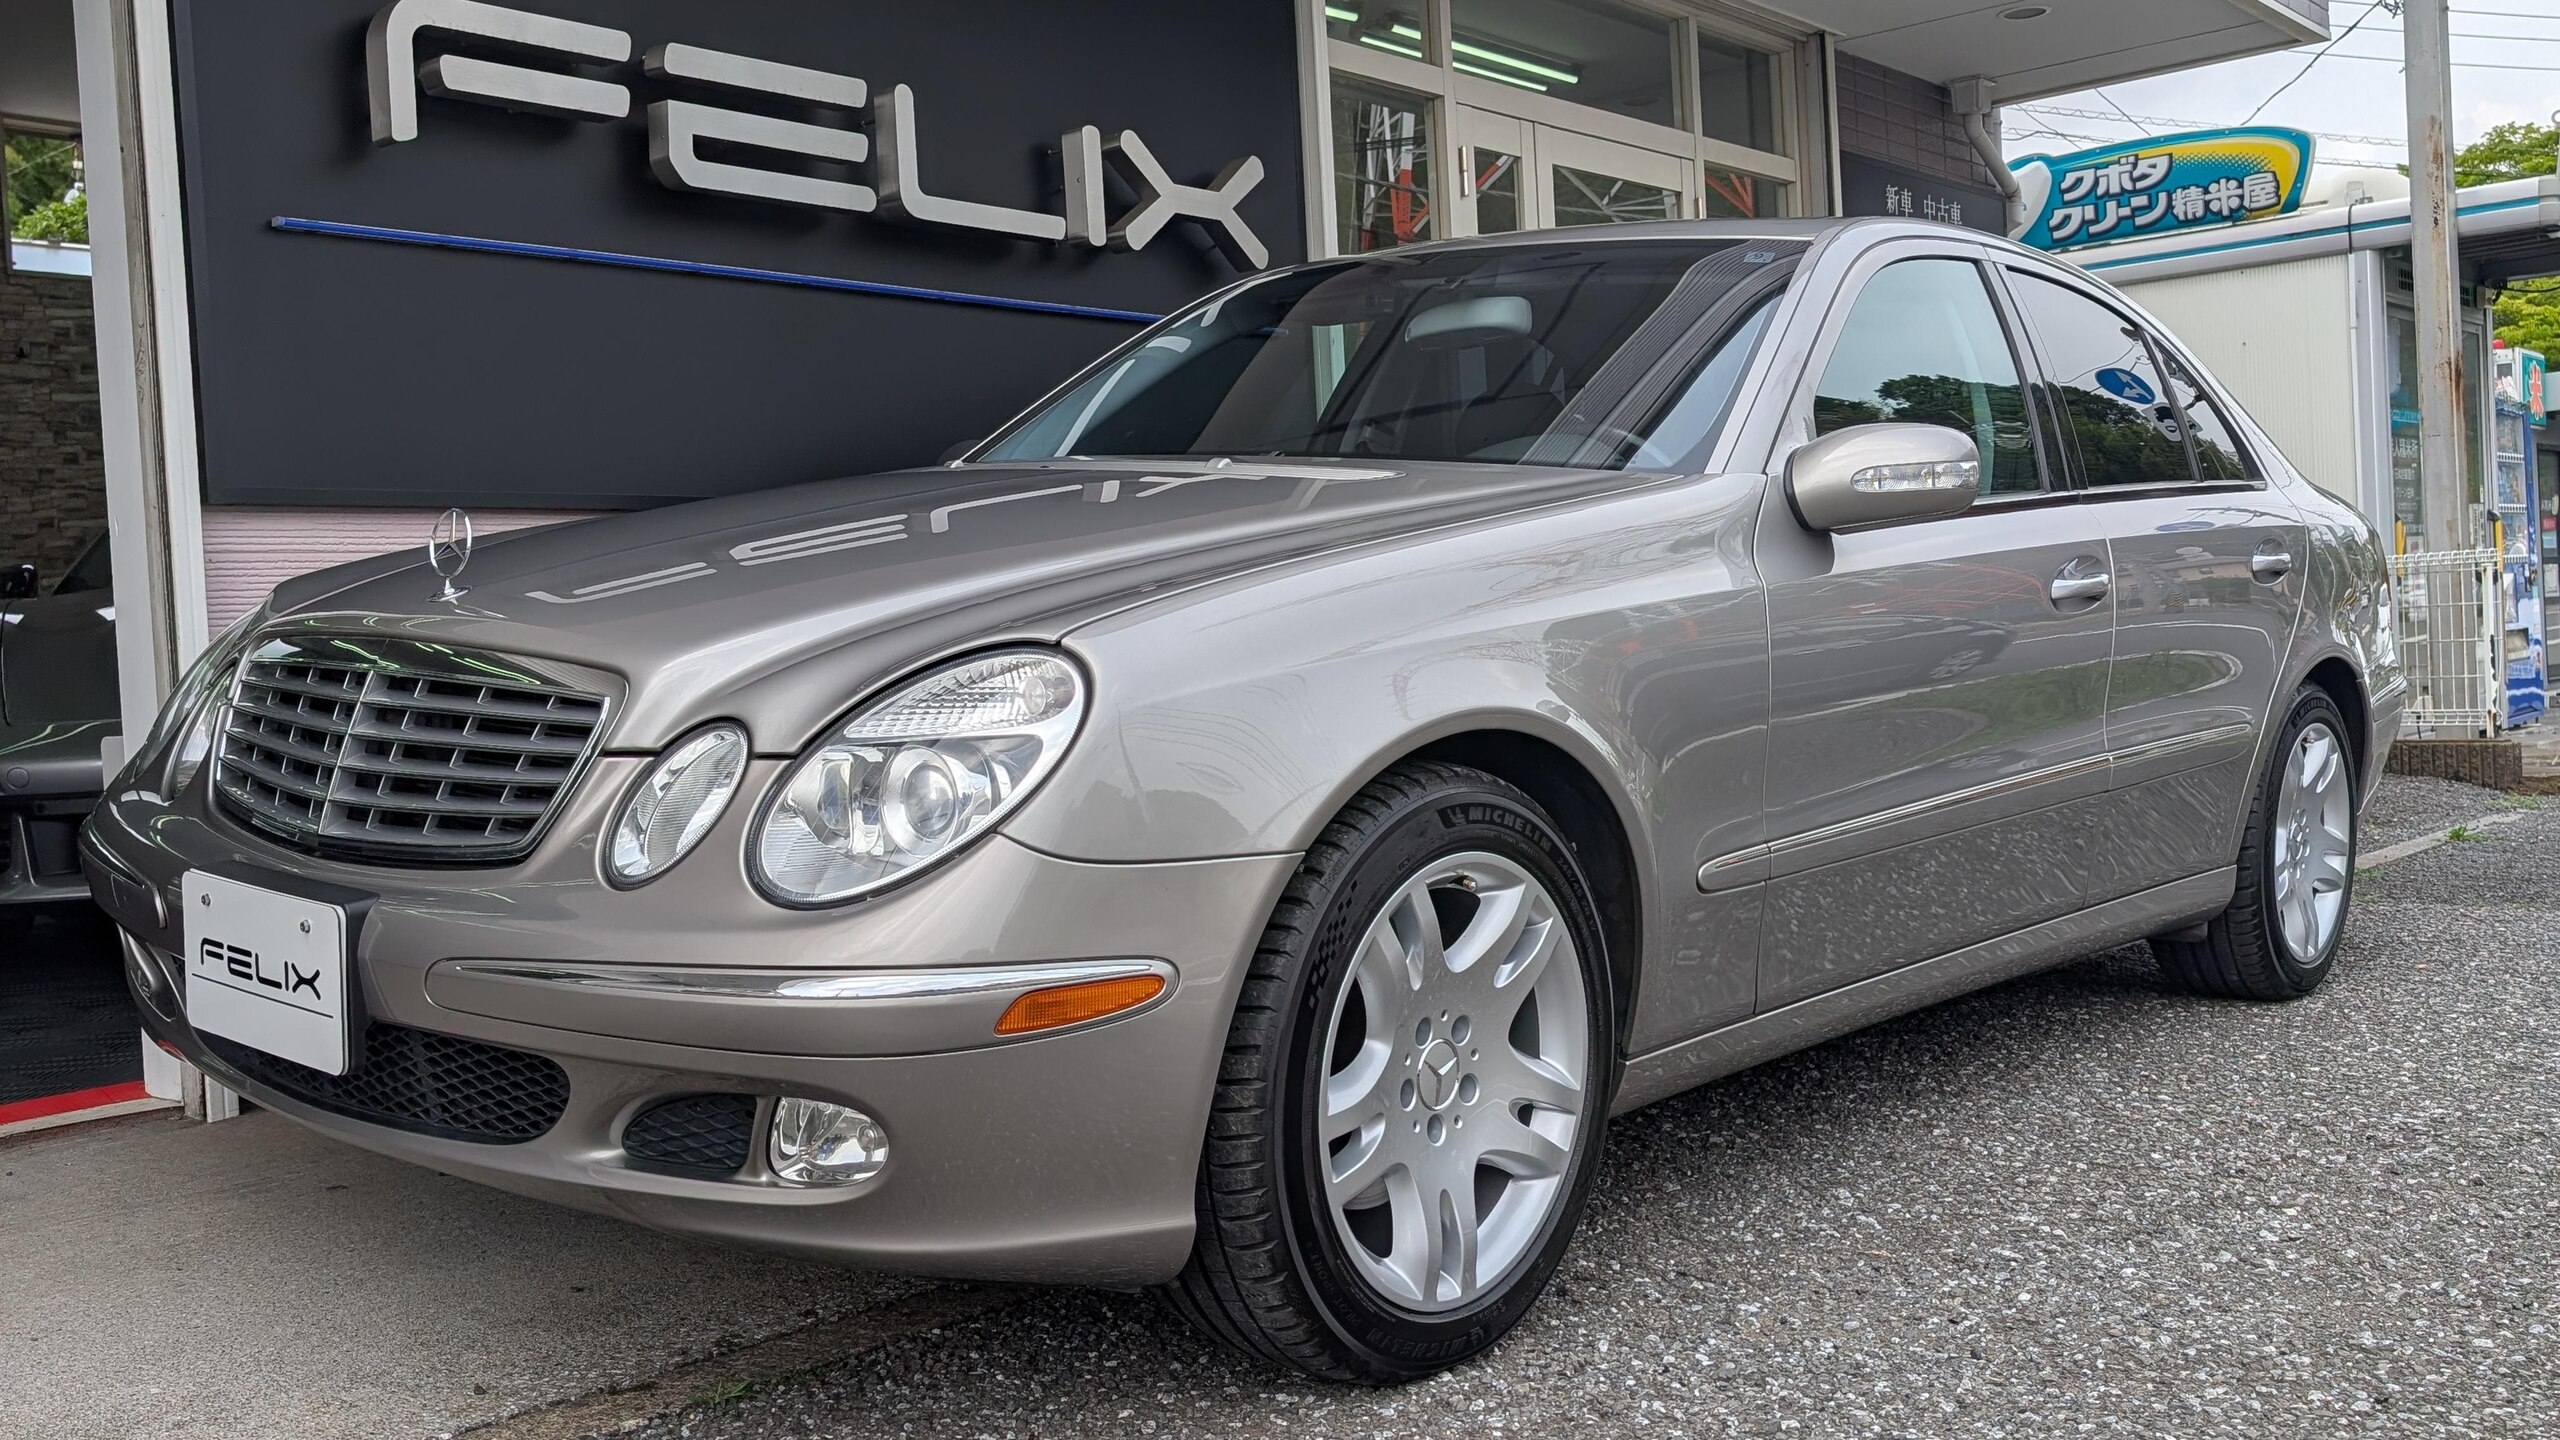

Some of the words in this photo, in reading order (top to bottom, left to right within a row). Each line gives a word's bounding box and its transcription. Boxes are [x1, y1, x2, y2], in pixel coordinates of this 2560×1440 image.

[366, 0, 1270, 270] FELIX
[1885, 184, 1913, 218] 新車
[1923, 194, 1962, 226] 中古車
[2060, 153, 2172, 202] クボタ
[2048, 172, 2282, 241] クリーン精米屋
[1468, 806, 1552, 853] MICHELIN
[200, 937, 322, 1001] FELIX
